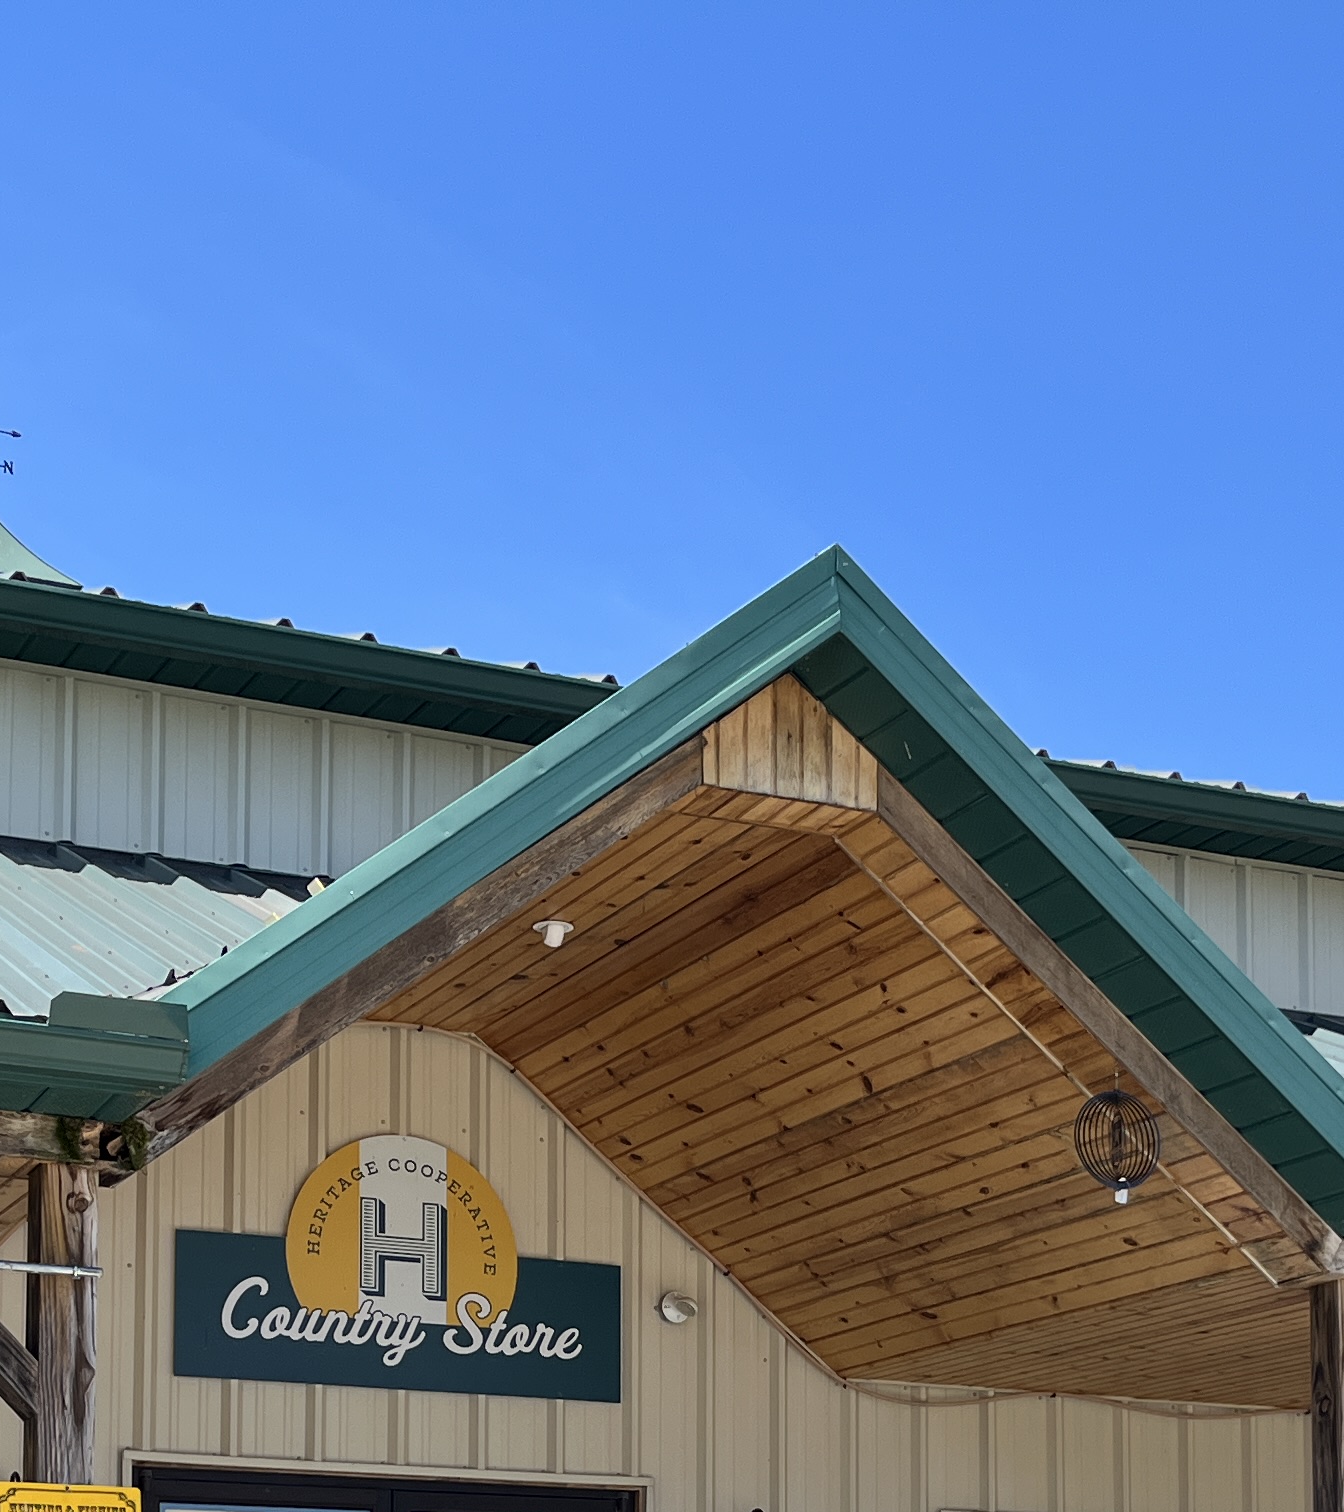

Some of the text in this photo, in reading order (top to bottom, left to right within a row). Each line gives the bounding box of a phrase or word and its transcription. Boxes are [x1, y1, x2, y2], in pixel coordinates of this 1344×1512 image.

[307, 1157, 497, 1277] HERITAGE COOPERATIVE
[360, 1196, 448, 1302] H
[221, 1275, 582, 1367] Country Store
